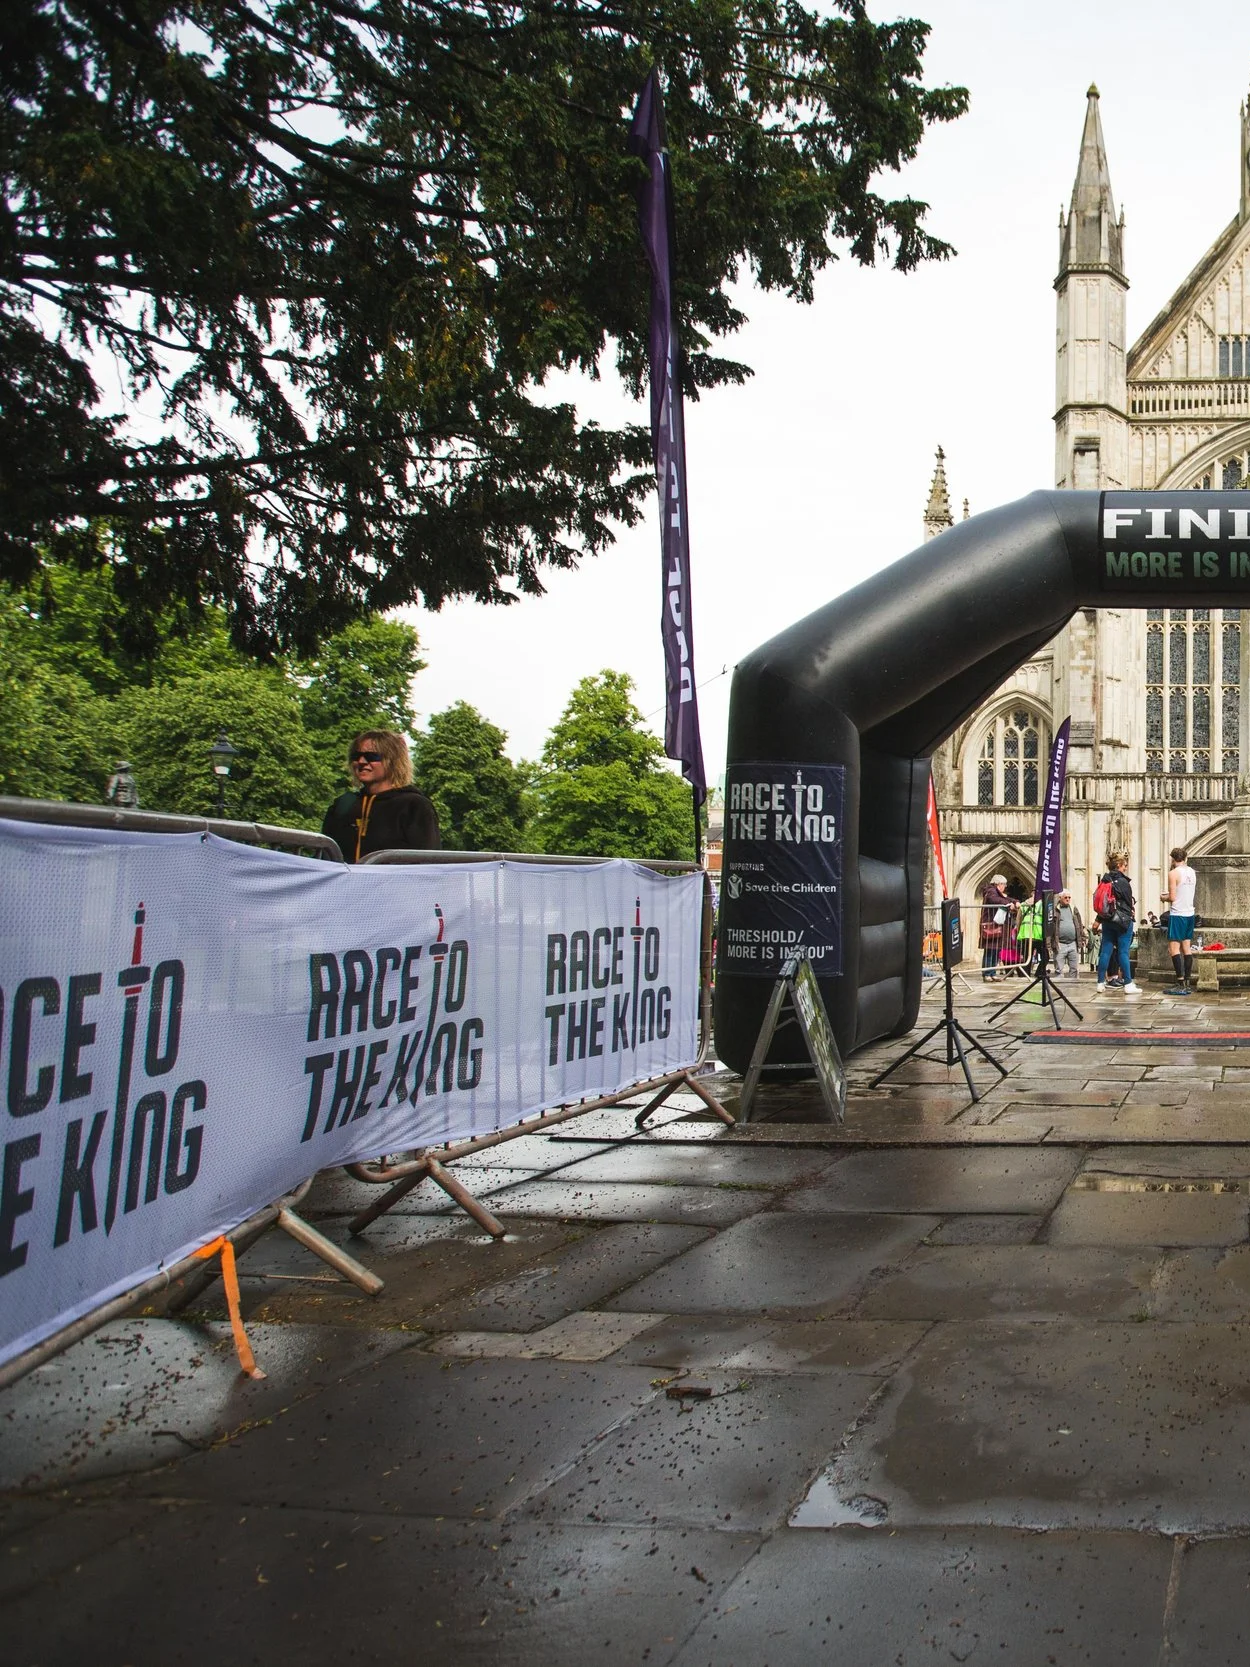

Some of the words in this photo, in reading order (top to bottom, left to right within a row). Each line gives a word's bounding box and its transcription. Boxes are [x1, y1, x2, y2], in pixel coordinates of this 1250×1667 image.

[1105, 551, 1183, 578] MORE
[1193, 551, 1220, 578] IS
[730, 783, 785, 811] RACE
[792, 781, 823, 812] TO
[730, 813, 767, 841] THE
[775, 813, 836, 843] KING
[745, 882, 770, 893] Save
[771, 882, 790, 893] the
[792, 882, 837, 893] Children
[546, 926, 624, 996] RACE
[630, 924, 660, 982] TO
[727, 945, 757, 959] MORE
[762, 946, 774, 959] IS
[306, 945, 423, 1042] RACE
[428, 938, 469, 1013] TO
[545, 998, 605, 1067] THE
[610, 985, 672, 1054] KING
[0, 972, 103, 1118] CE
[118, 958, 185, 1078] TO
[301, 1039, 392, 1143] THE
[379, 1017, 485, 1111] KING
[53, 1079, 208, 1248] KING
